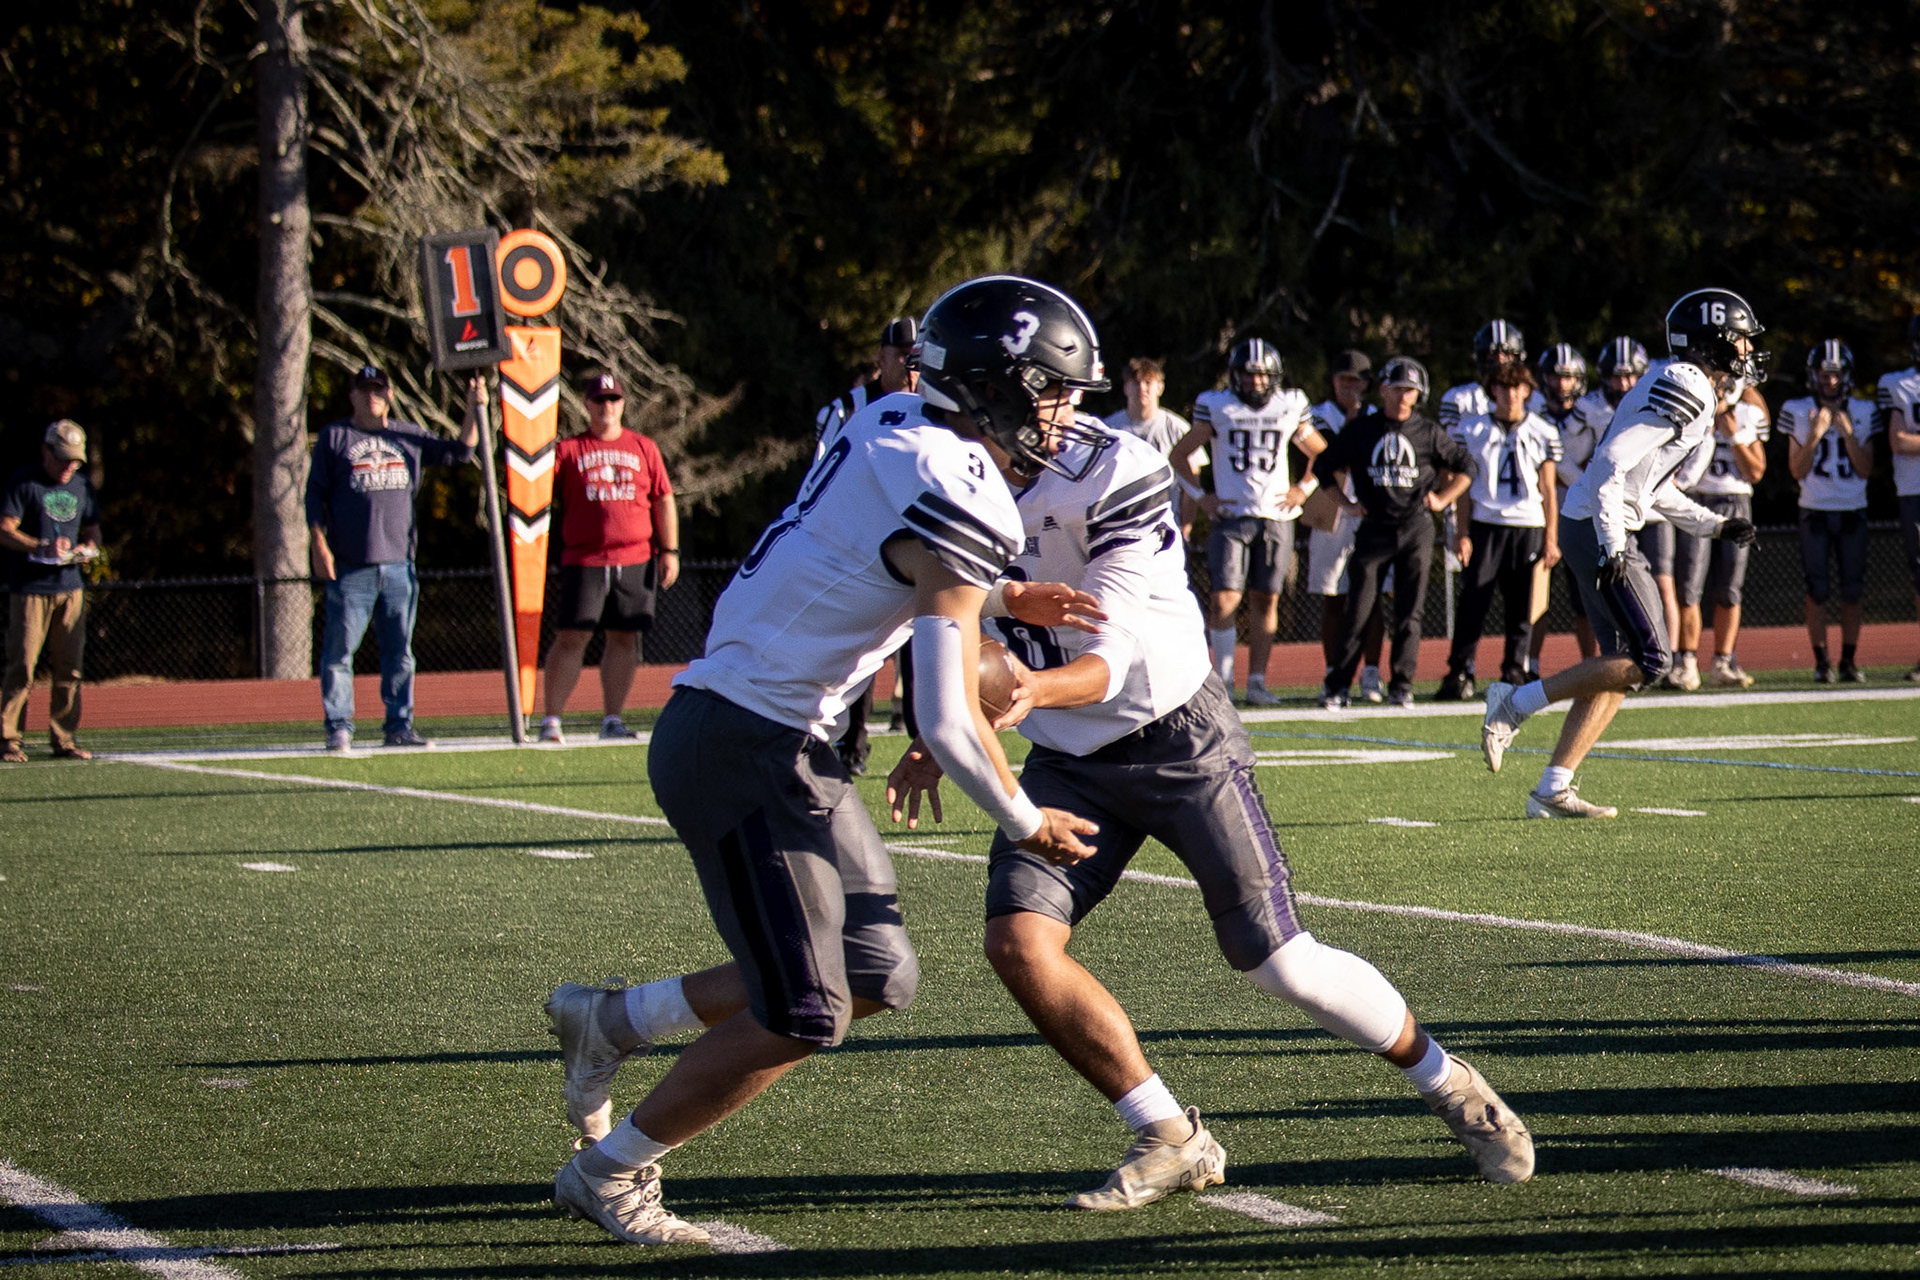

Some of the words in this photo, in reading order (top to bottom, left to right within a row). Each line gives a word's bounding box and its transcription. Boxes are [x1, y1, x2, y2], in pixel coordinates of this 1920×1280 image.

[443, 246, 482, 318] 1
[1700, 302, 1726, 326] 16
[1001, 311, 1041, 355] 3
[364, 366, 377, 378] N
[601, 374, 615, 390] N
[968, 453, 985, 481] 3
[1229, 429, 1281, 474] 33
[1497, 451, 1520, 497] 4
